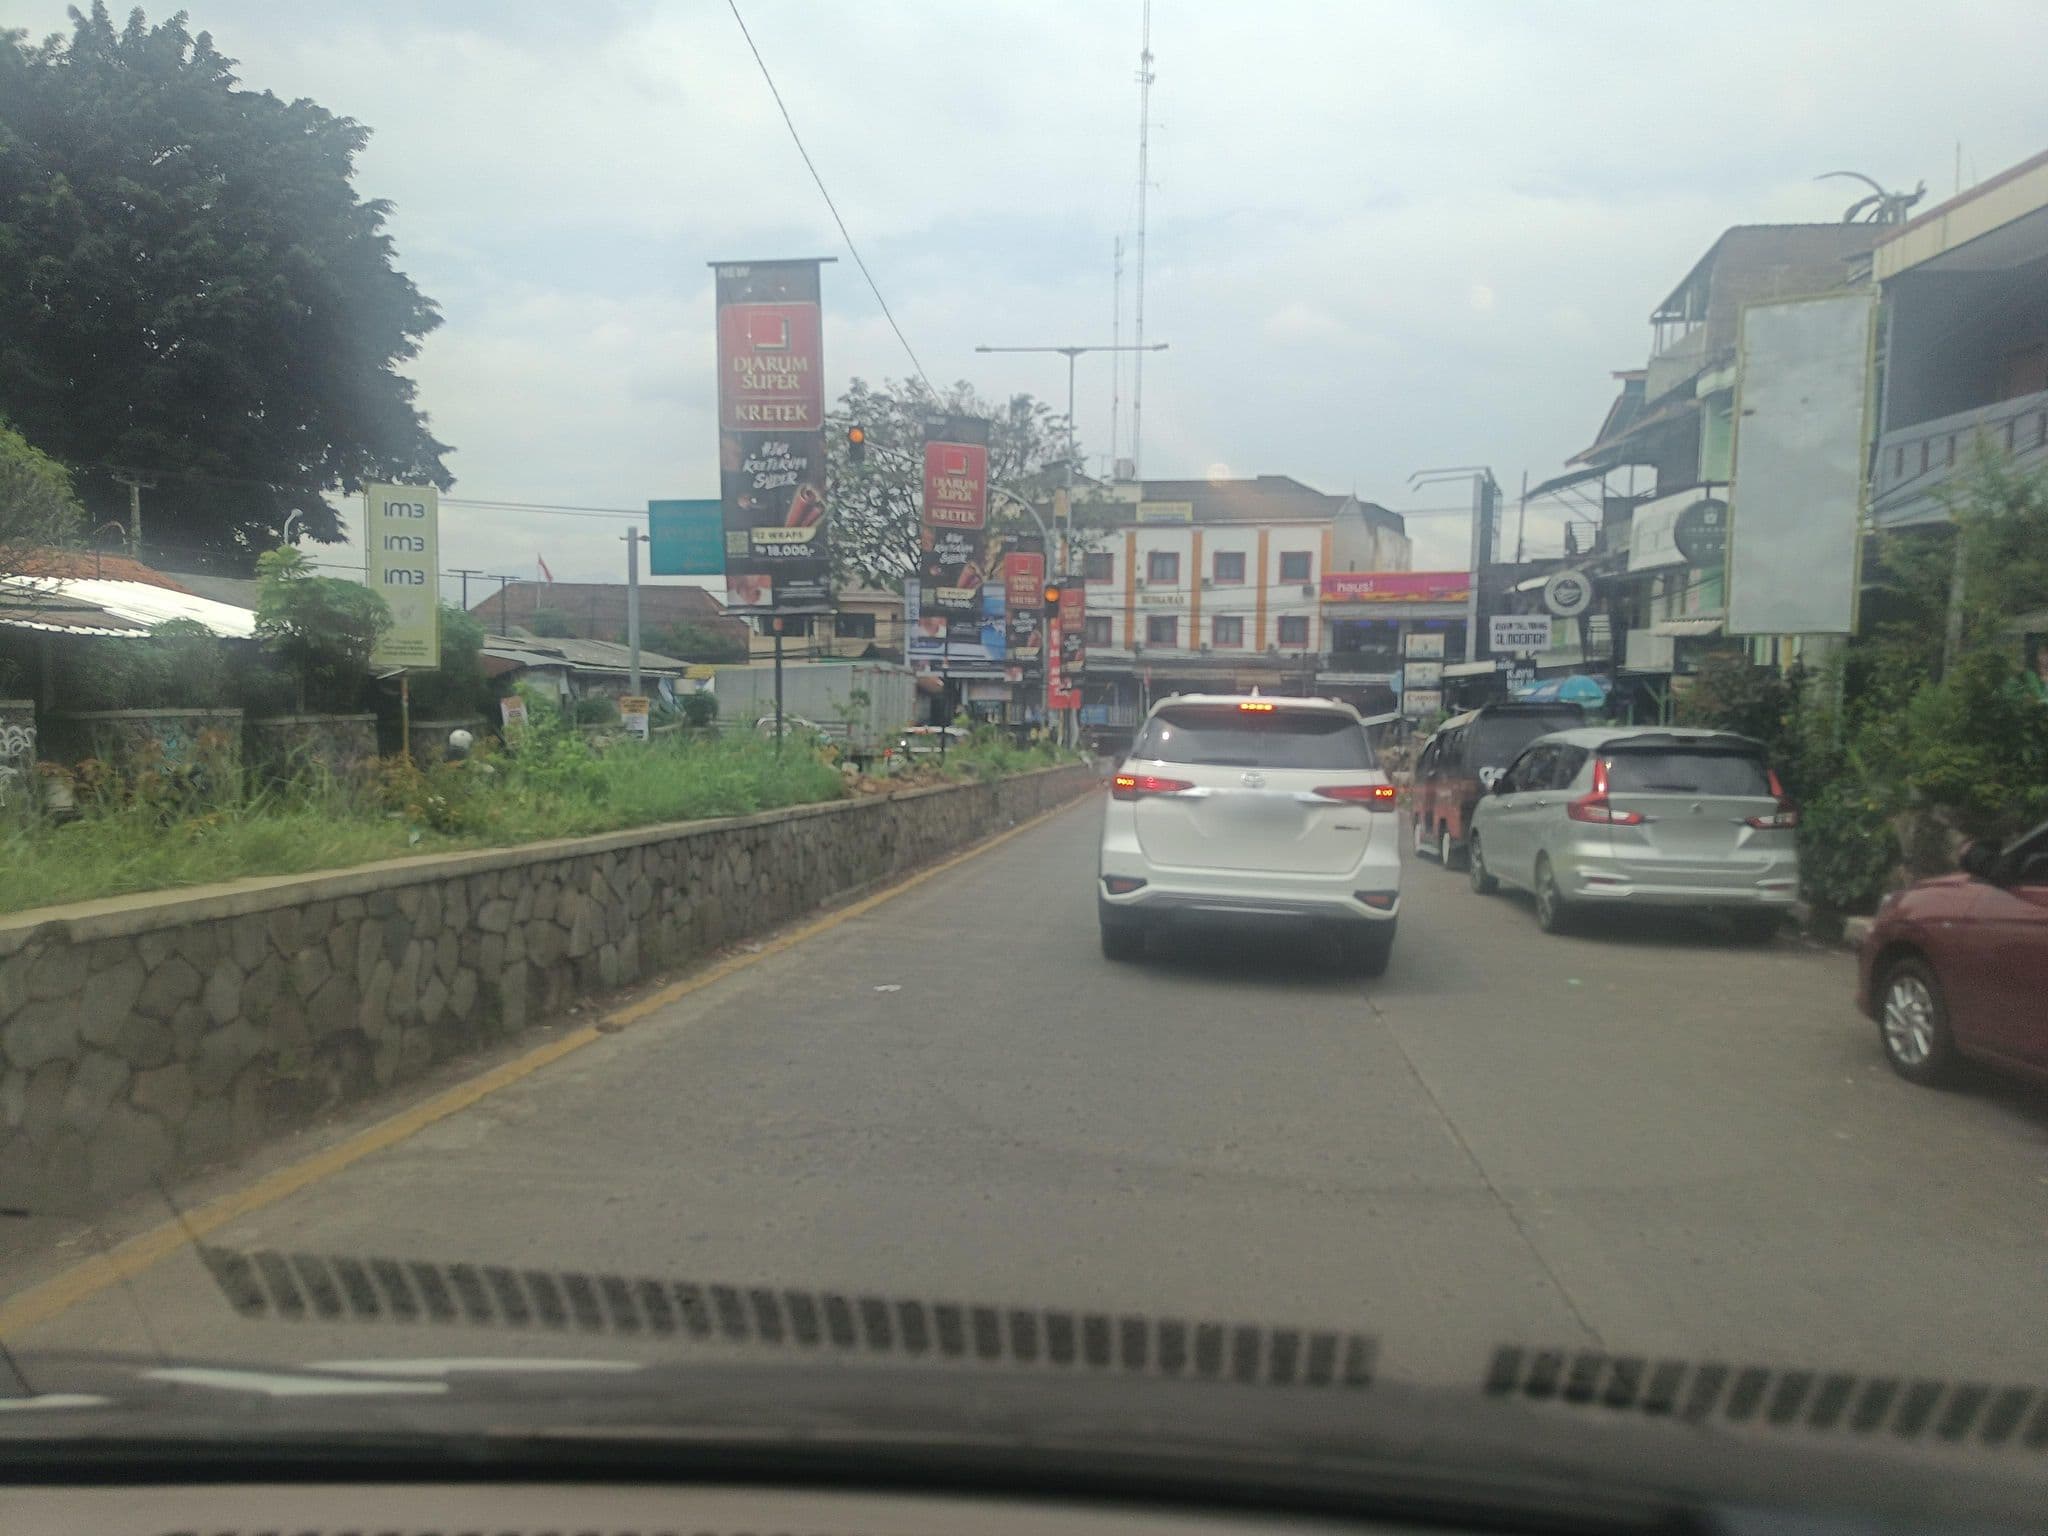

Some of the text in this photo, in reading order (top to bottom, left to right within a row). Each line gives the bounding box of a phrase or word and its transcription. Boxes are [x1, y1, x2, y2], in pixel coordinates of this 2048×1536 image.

[733, 356, 808, 375] DJARUM
[743, 373, 801, 389] SUPER
[735, 404, 808, 421] KRETEK
[1336, 580, 1374, 593] haus!
